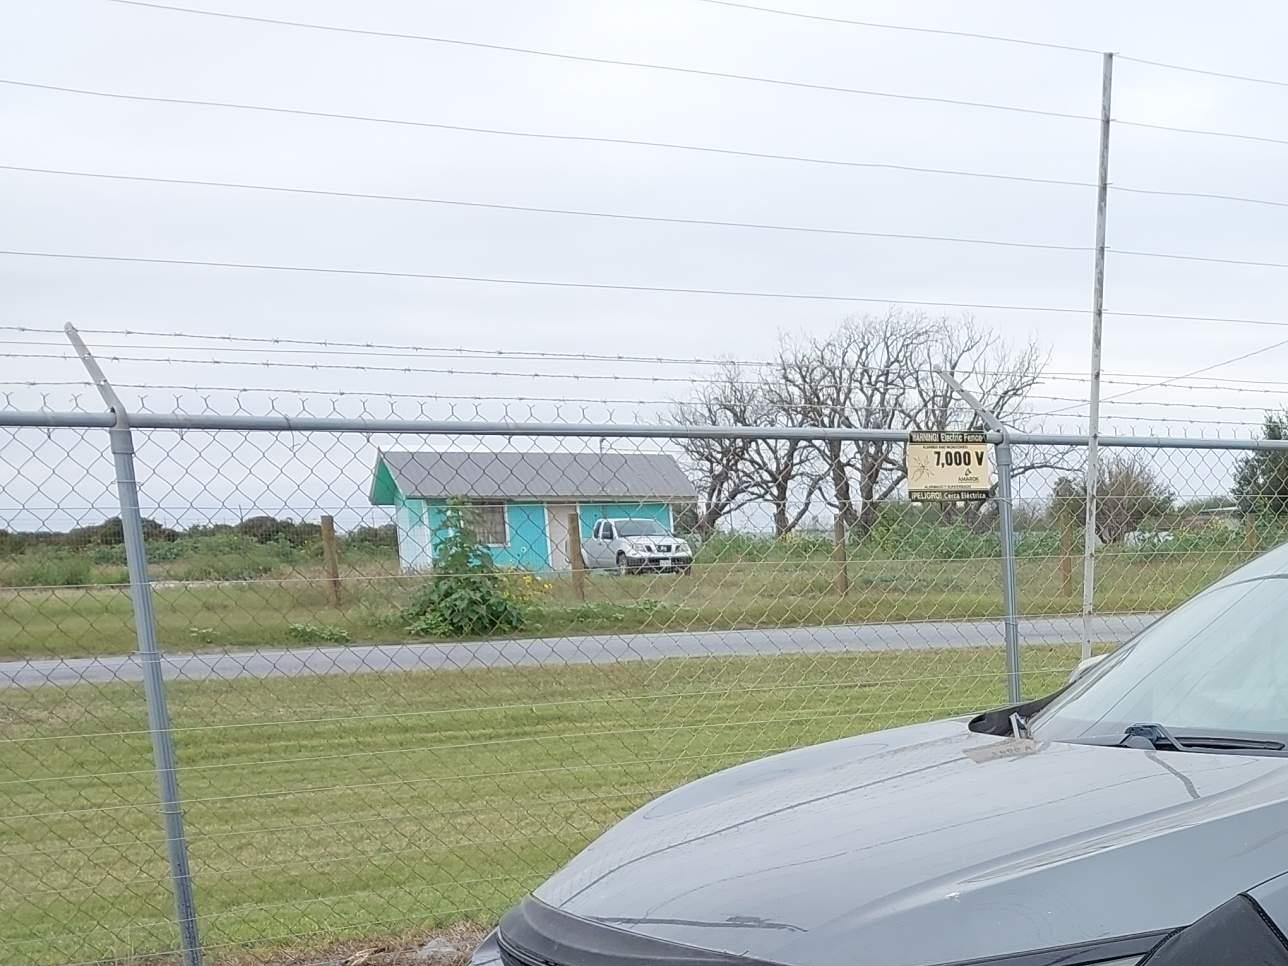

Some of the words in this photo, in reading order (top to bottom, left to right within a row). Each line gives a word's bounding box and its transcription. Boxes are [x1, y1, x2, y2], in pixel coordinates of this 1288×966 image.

[940, 432, 962, 442] Electric
[934, 451, 971, 468] 7,000
[975, 451, 984, 466] V
